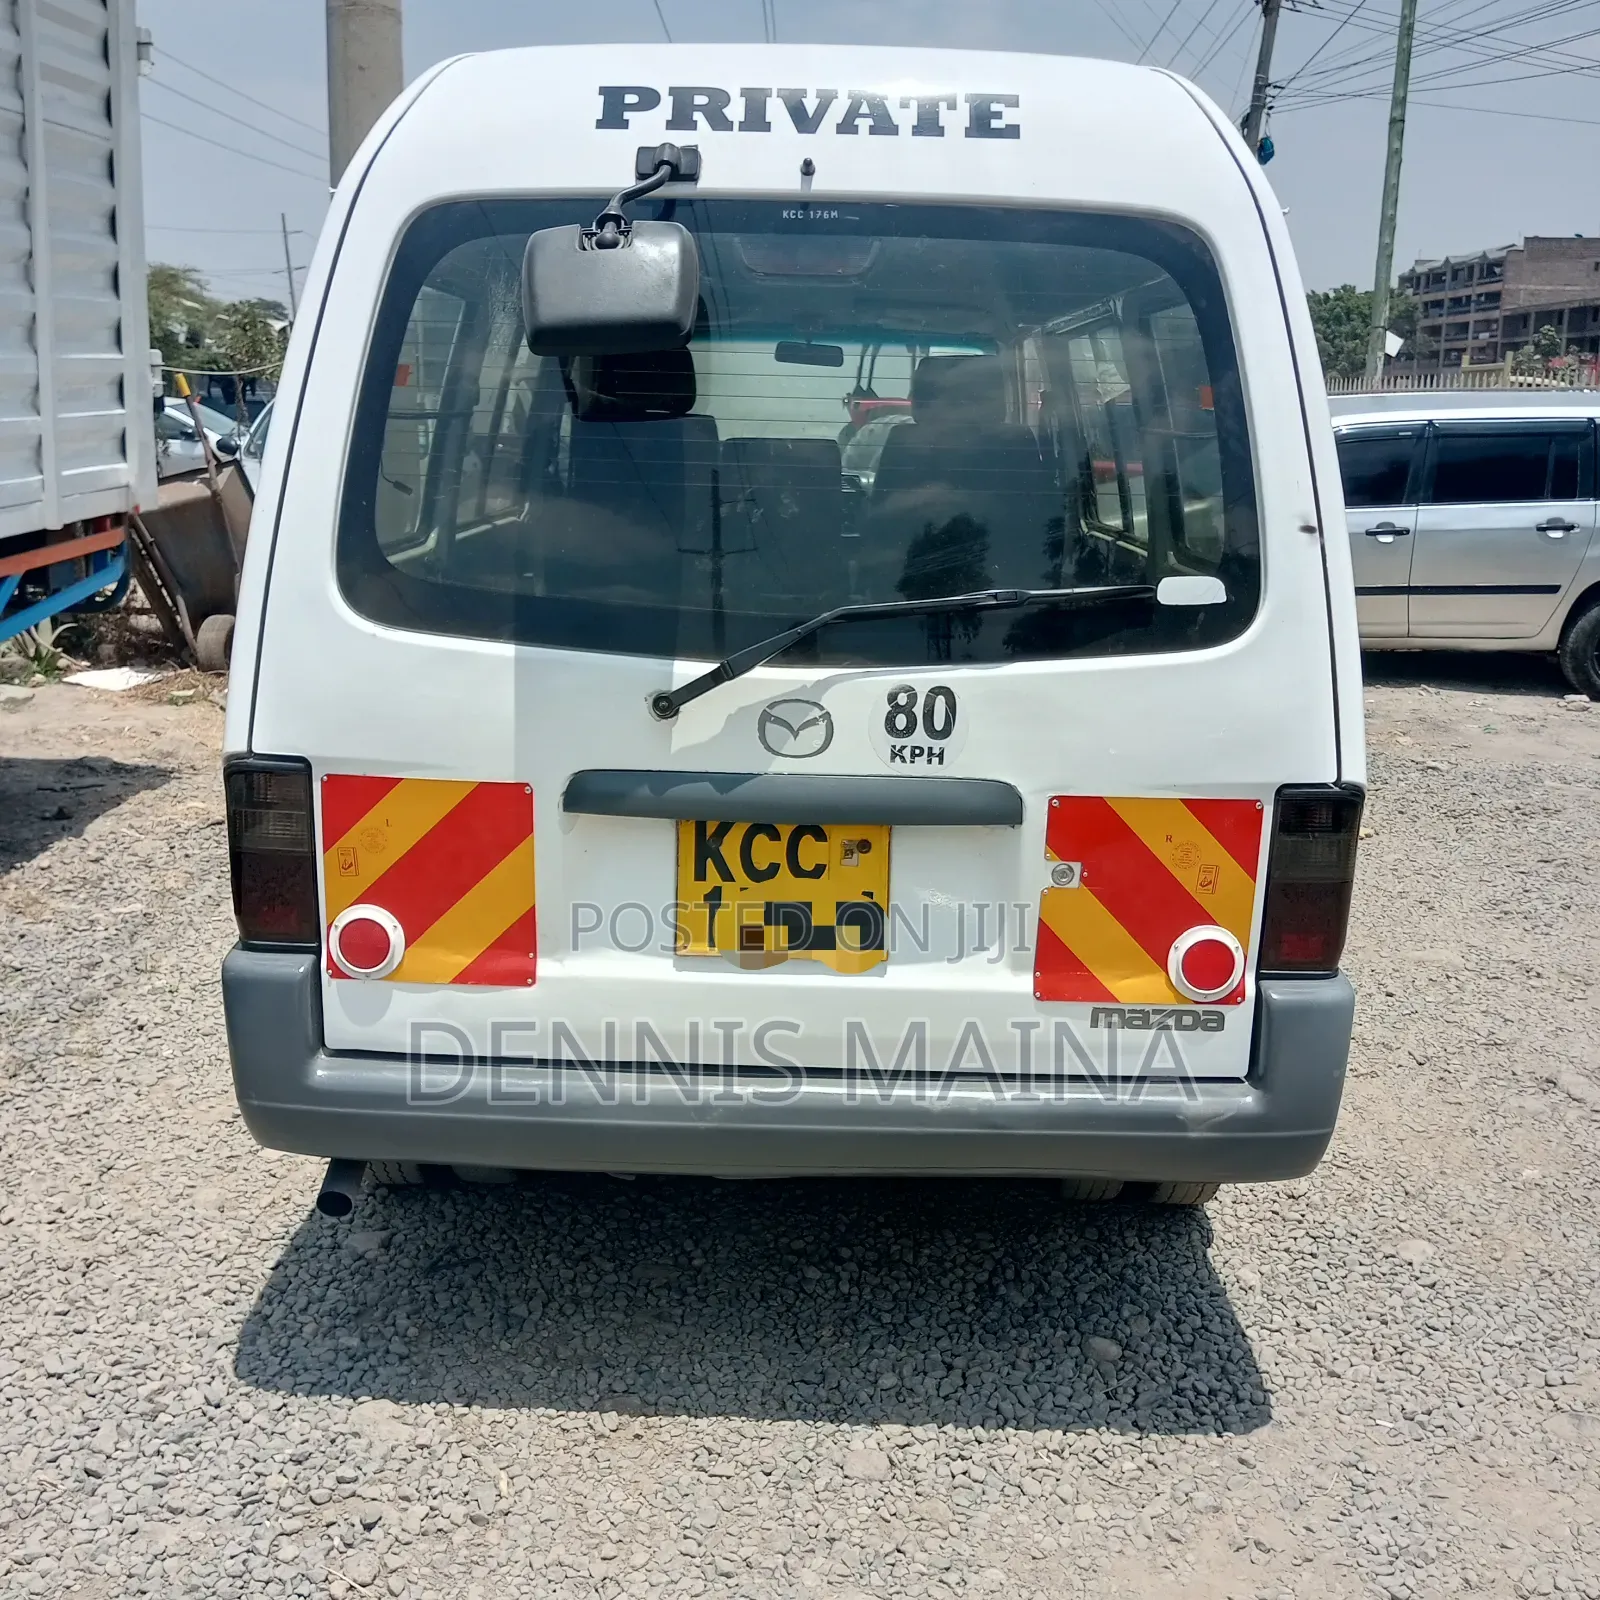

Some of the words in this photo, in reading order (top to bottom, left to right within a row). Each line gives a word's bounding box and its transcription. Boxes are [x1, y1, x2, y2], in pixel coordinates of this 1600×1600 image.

[595, 86, 1020, 139] PRIVATE
[782, 210, 804, 219] KCC
[809, 210, 838, 219] 176M
[884, 683, 957, 741] 80
[890, 744, 944, 766] KPH
[693, 821, 828, 883] KCC
